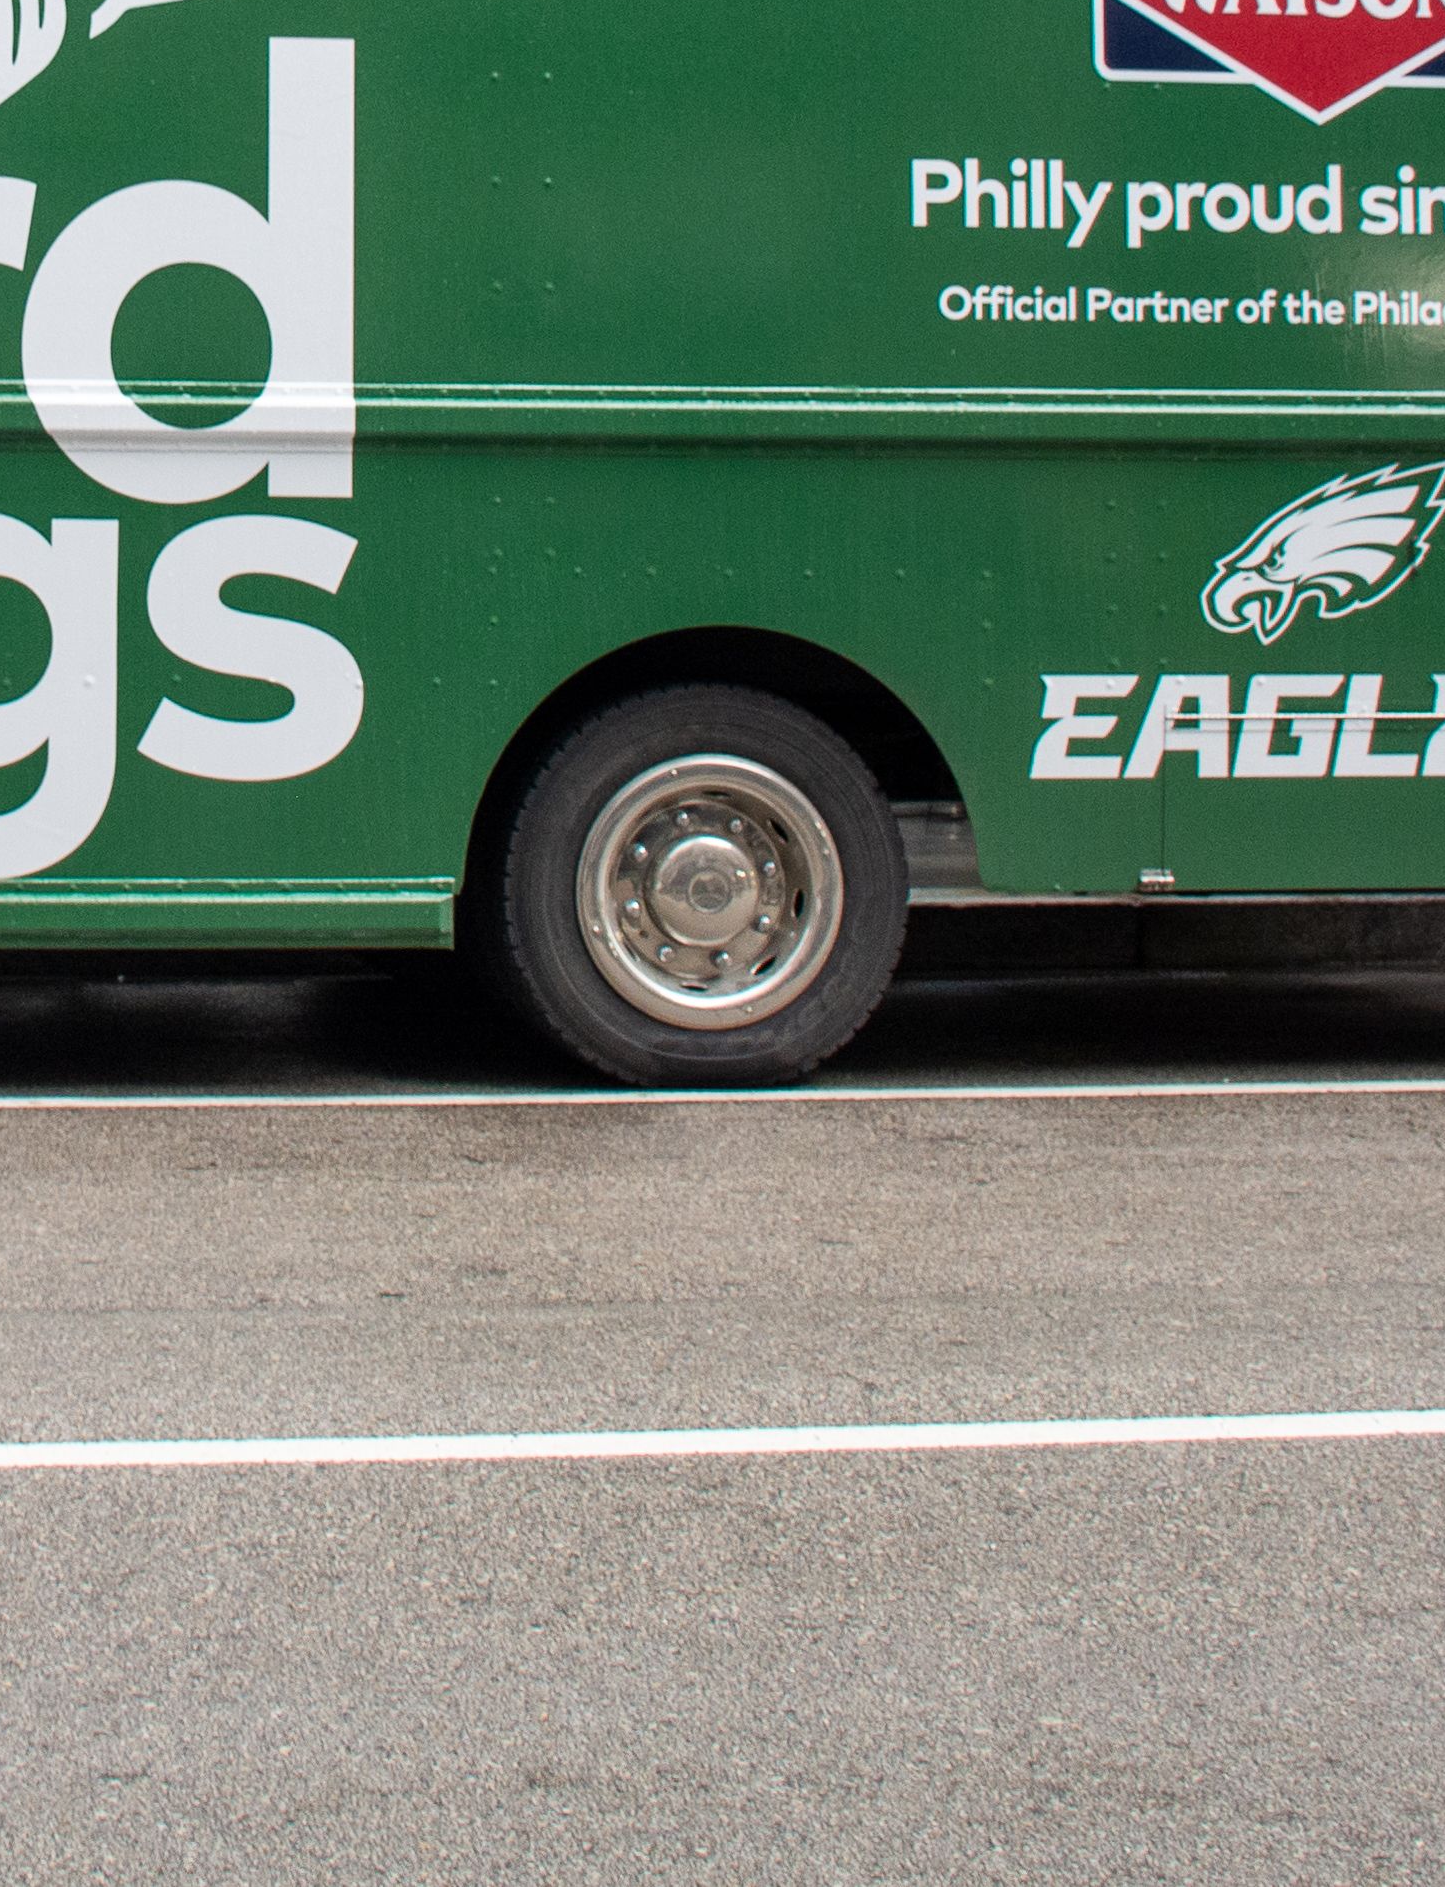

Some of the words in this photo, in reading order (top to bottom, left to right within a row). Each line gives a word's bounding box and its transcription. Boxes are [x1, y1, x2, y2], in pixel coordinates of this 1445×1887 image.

[912, 158, 1112, 248] Philly
[1127, 164, 1343, 249] proud
[939, 285, 1077, 321] Official
[1087, 288, 1229, 323] Partner
[1238, 288, 1278, 324] of
[1284, 289, 1346, 325] the
